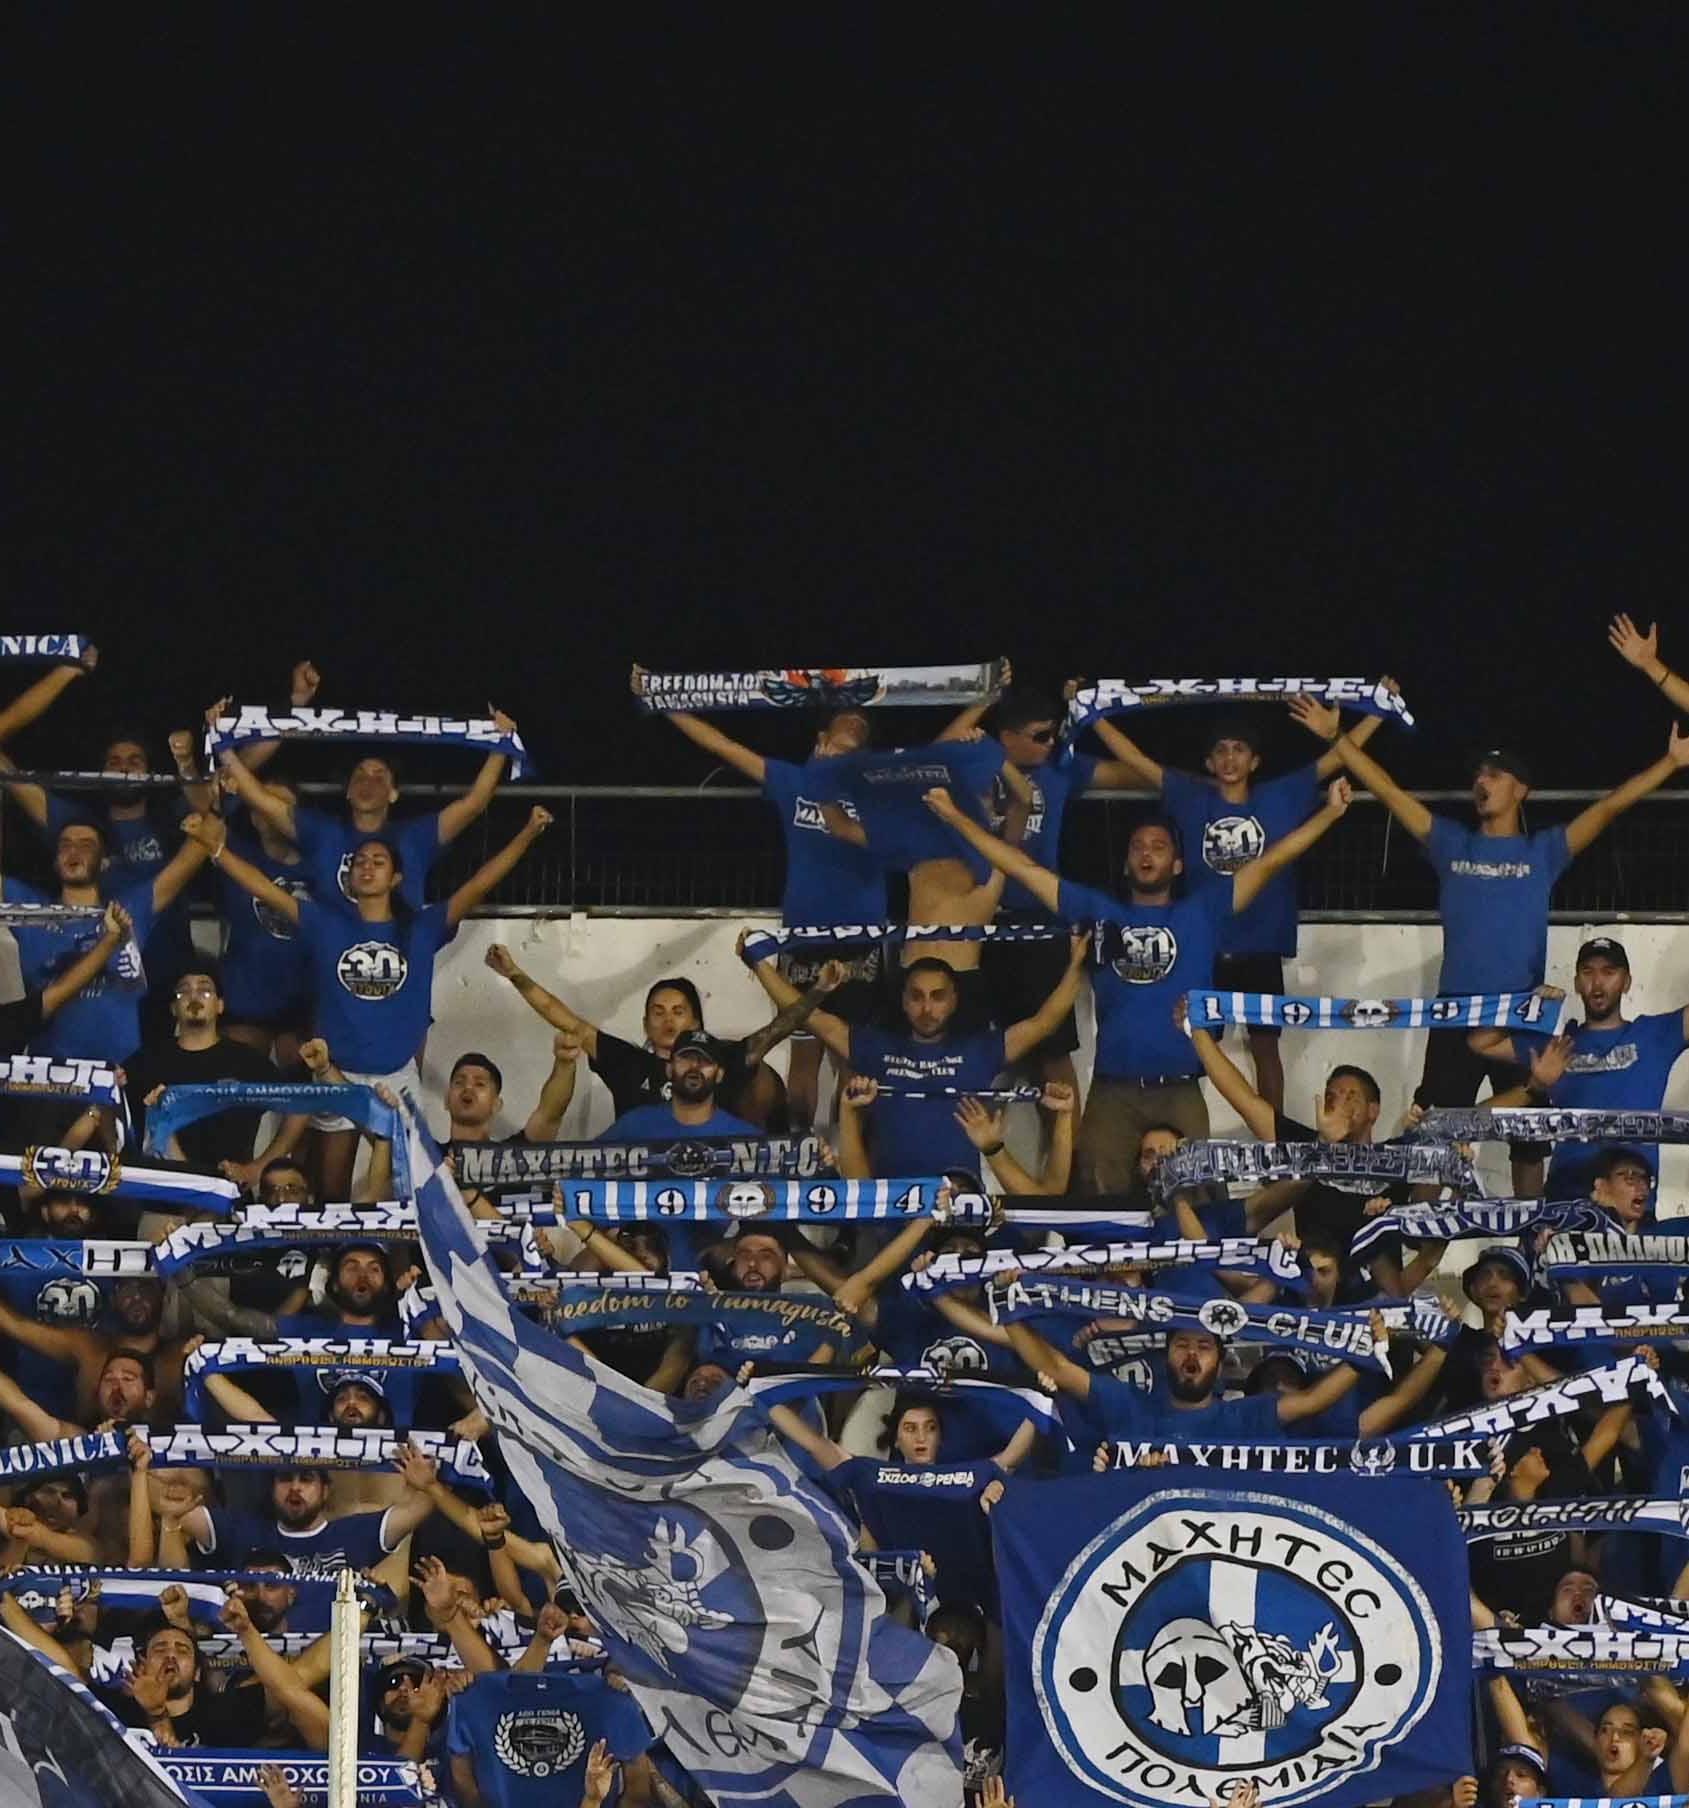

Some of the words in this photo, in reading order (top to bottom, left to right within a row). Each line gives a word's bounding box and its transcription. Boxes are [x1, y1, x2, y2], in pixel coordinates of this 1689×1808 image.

[1006, 1286, 1173, 1325] ATHENS
[1267, 1309, 1373, 1356] CLUB
[1408, 1439, 1484, 1470] U.K
